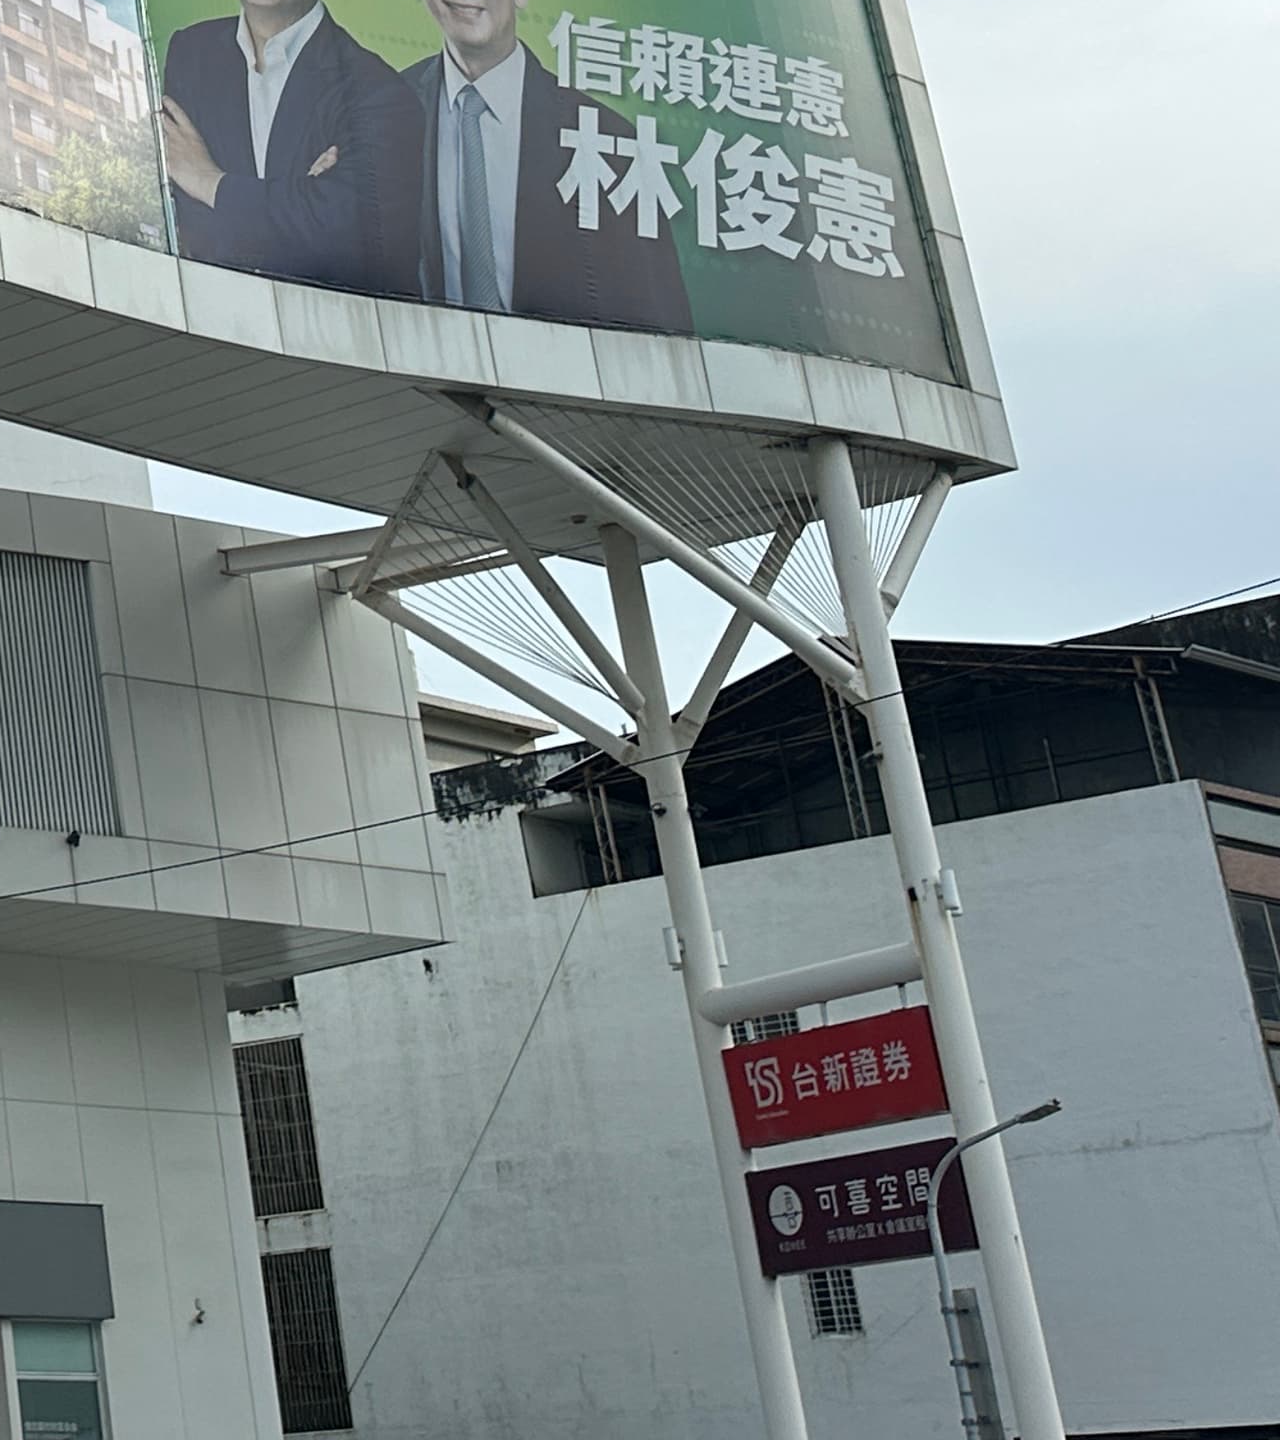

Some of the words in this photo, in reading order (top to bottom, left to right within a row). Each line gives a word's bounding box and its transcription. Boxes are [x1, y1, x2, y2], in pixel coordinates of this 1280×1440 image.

[547, 9, 849, 139] 信賴連憲
[556, 104, 906, 280] 林俊憲
[792, 1040, 912, 1101] 台新證券
[814, 1167, 931, 1218] 可喜空間
